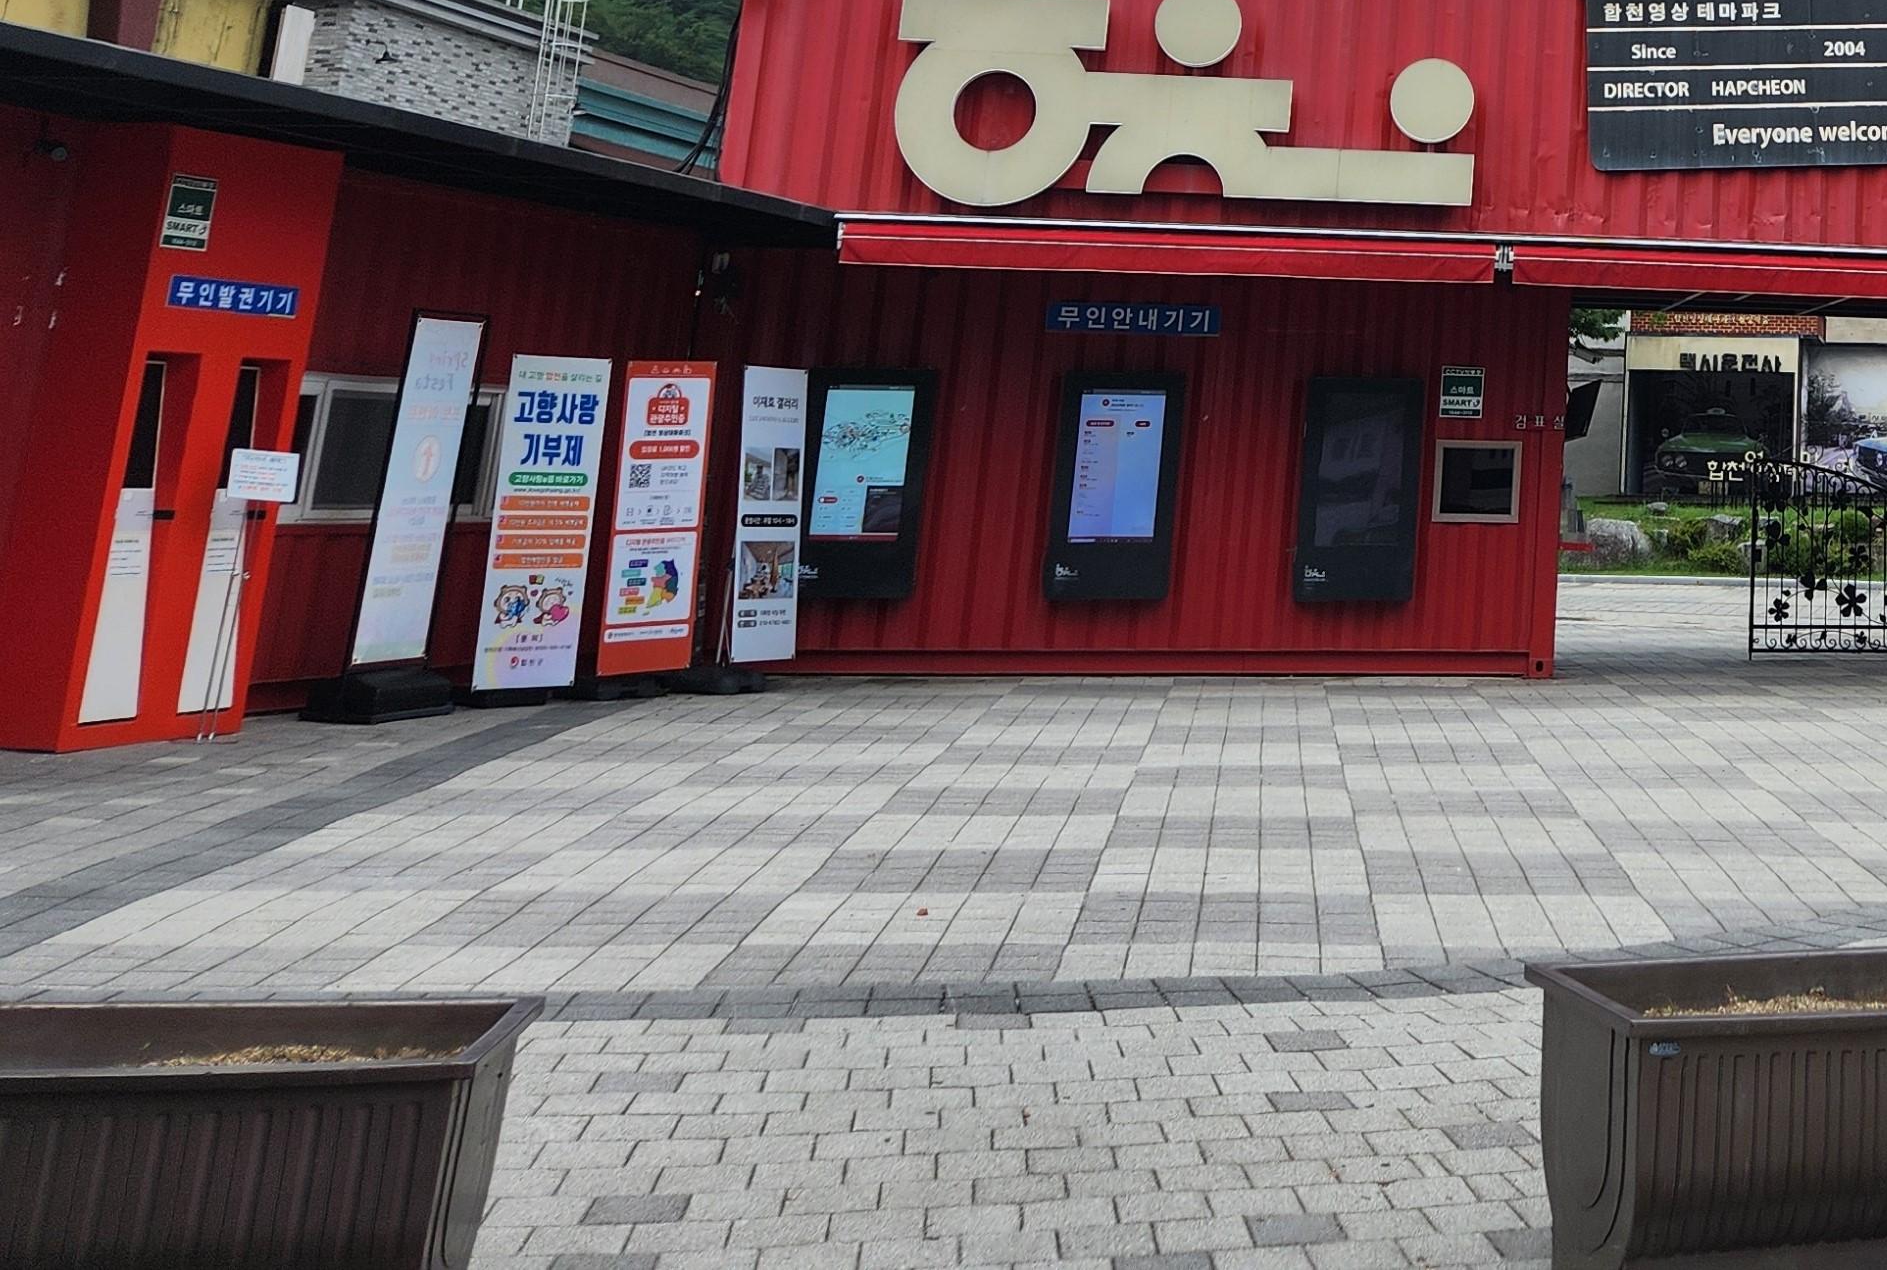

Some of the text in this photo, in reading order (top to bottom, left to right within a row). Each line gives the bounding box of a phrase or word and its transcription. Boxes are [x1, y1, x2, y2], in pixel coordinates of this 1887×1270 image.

[1603, 2, 1781, 22] 합천영상 테마파크
[1632, 41, 1866, 59] Since 2004
[1604, 80, 1806, 99] DIRECTOR HAPCHEON
[1713, 123, 1813, 148] Everyone
[166, 220, 199, 233] SMART
[177, 282, 293, 313] 무인발권기기
[1058, 306, 1210, 332] 무인안내기기
[514, 390, 599, 424] 고향사랑
[1443, 399, 1472, 407] SMART
[520, 433, 584, 466] 기부제
